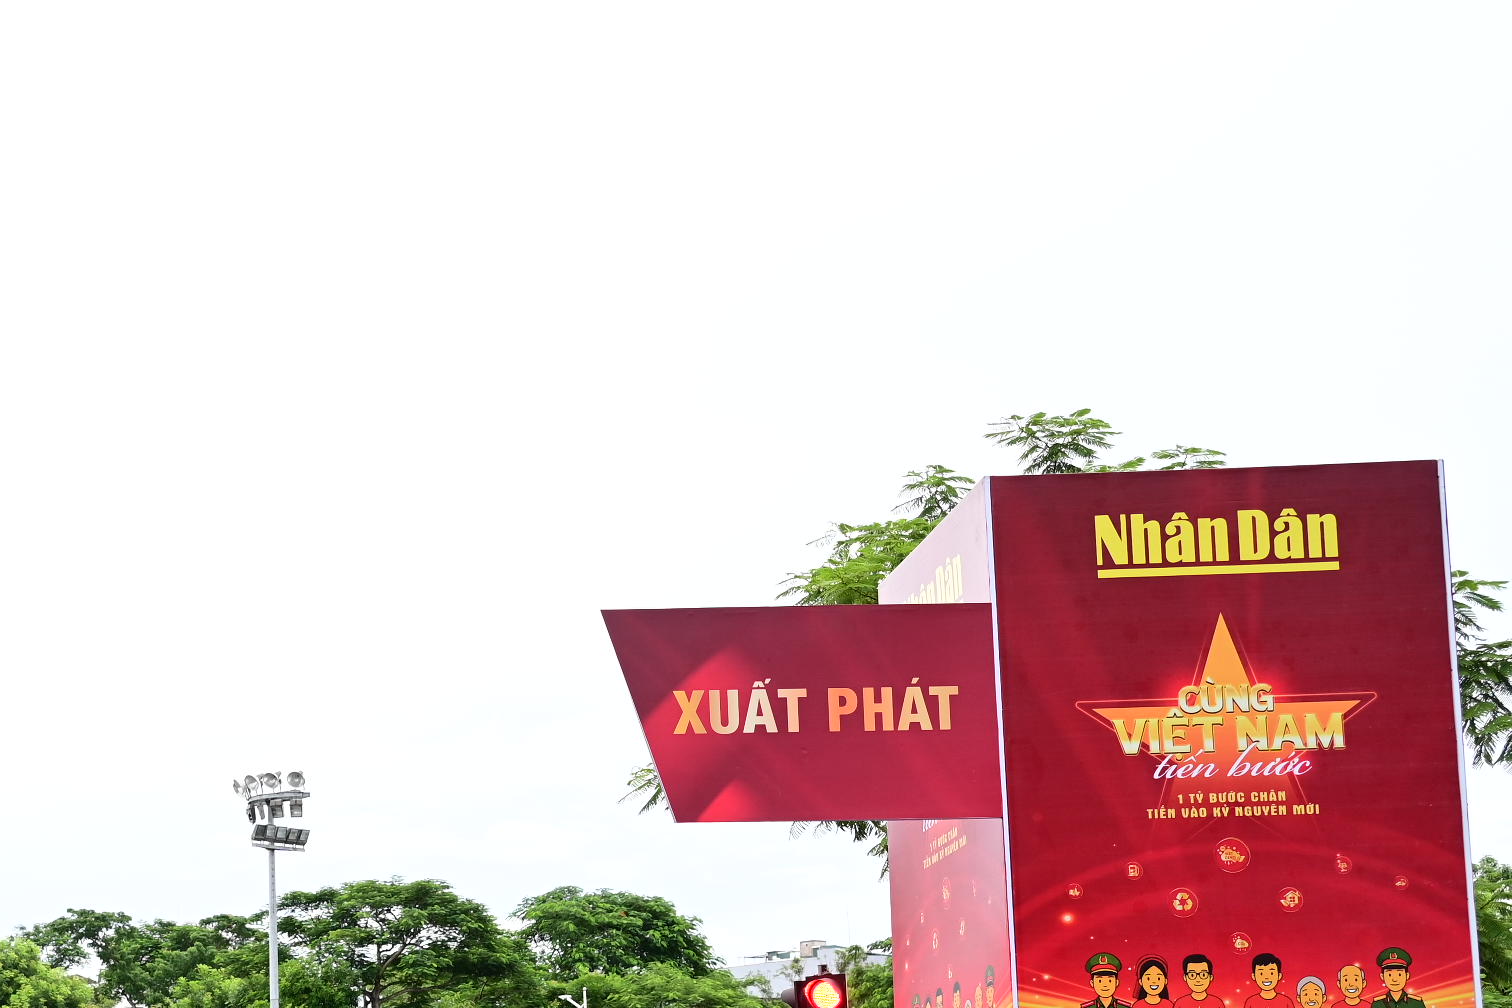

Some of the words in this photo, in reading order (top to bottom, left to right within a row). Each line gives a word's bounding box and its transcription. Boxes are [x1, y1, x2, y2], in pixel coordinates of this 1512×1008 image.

[1095, 511, 1230, 566] Nhân
[1238, 508, 1340, 561] Dân
[672, 678, 807, 735] XUẤT
[827, 677, 959, 732] PHÁT
[1178, 677, 1274, 715] CÙNG
[1112, 708, 1224, 761] VIỆT
[1236, 713, 1346, 753] NAM
[1153, 748, 1220, 780] tiến
[1227, 742, 1312, 778] bước
[1147, 805, 1176, 819] TIẾN
[1181, 804, 1207, 818] VÀO
[1234, 803, 1287, 817] NGUYÊN
[1292, 802, 1320, 815] MỚI
[1178, 794, 1183, 804] 1
[1209, 790, 1245, 803] BƯỚC
[1250, 789, 1286, 802] CHÂN
